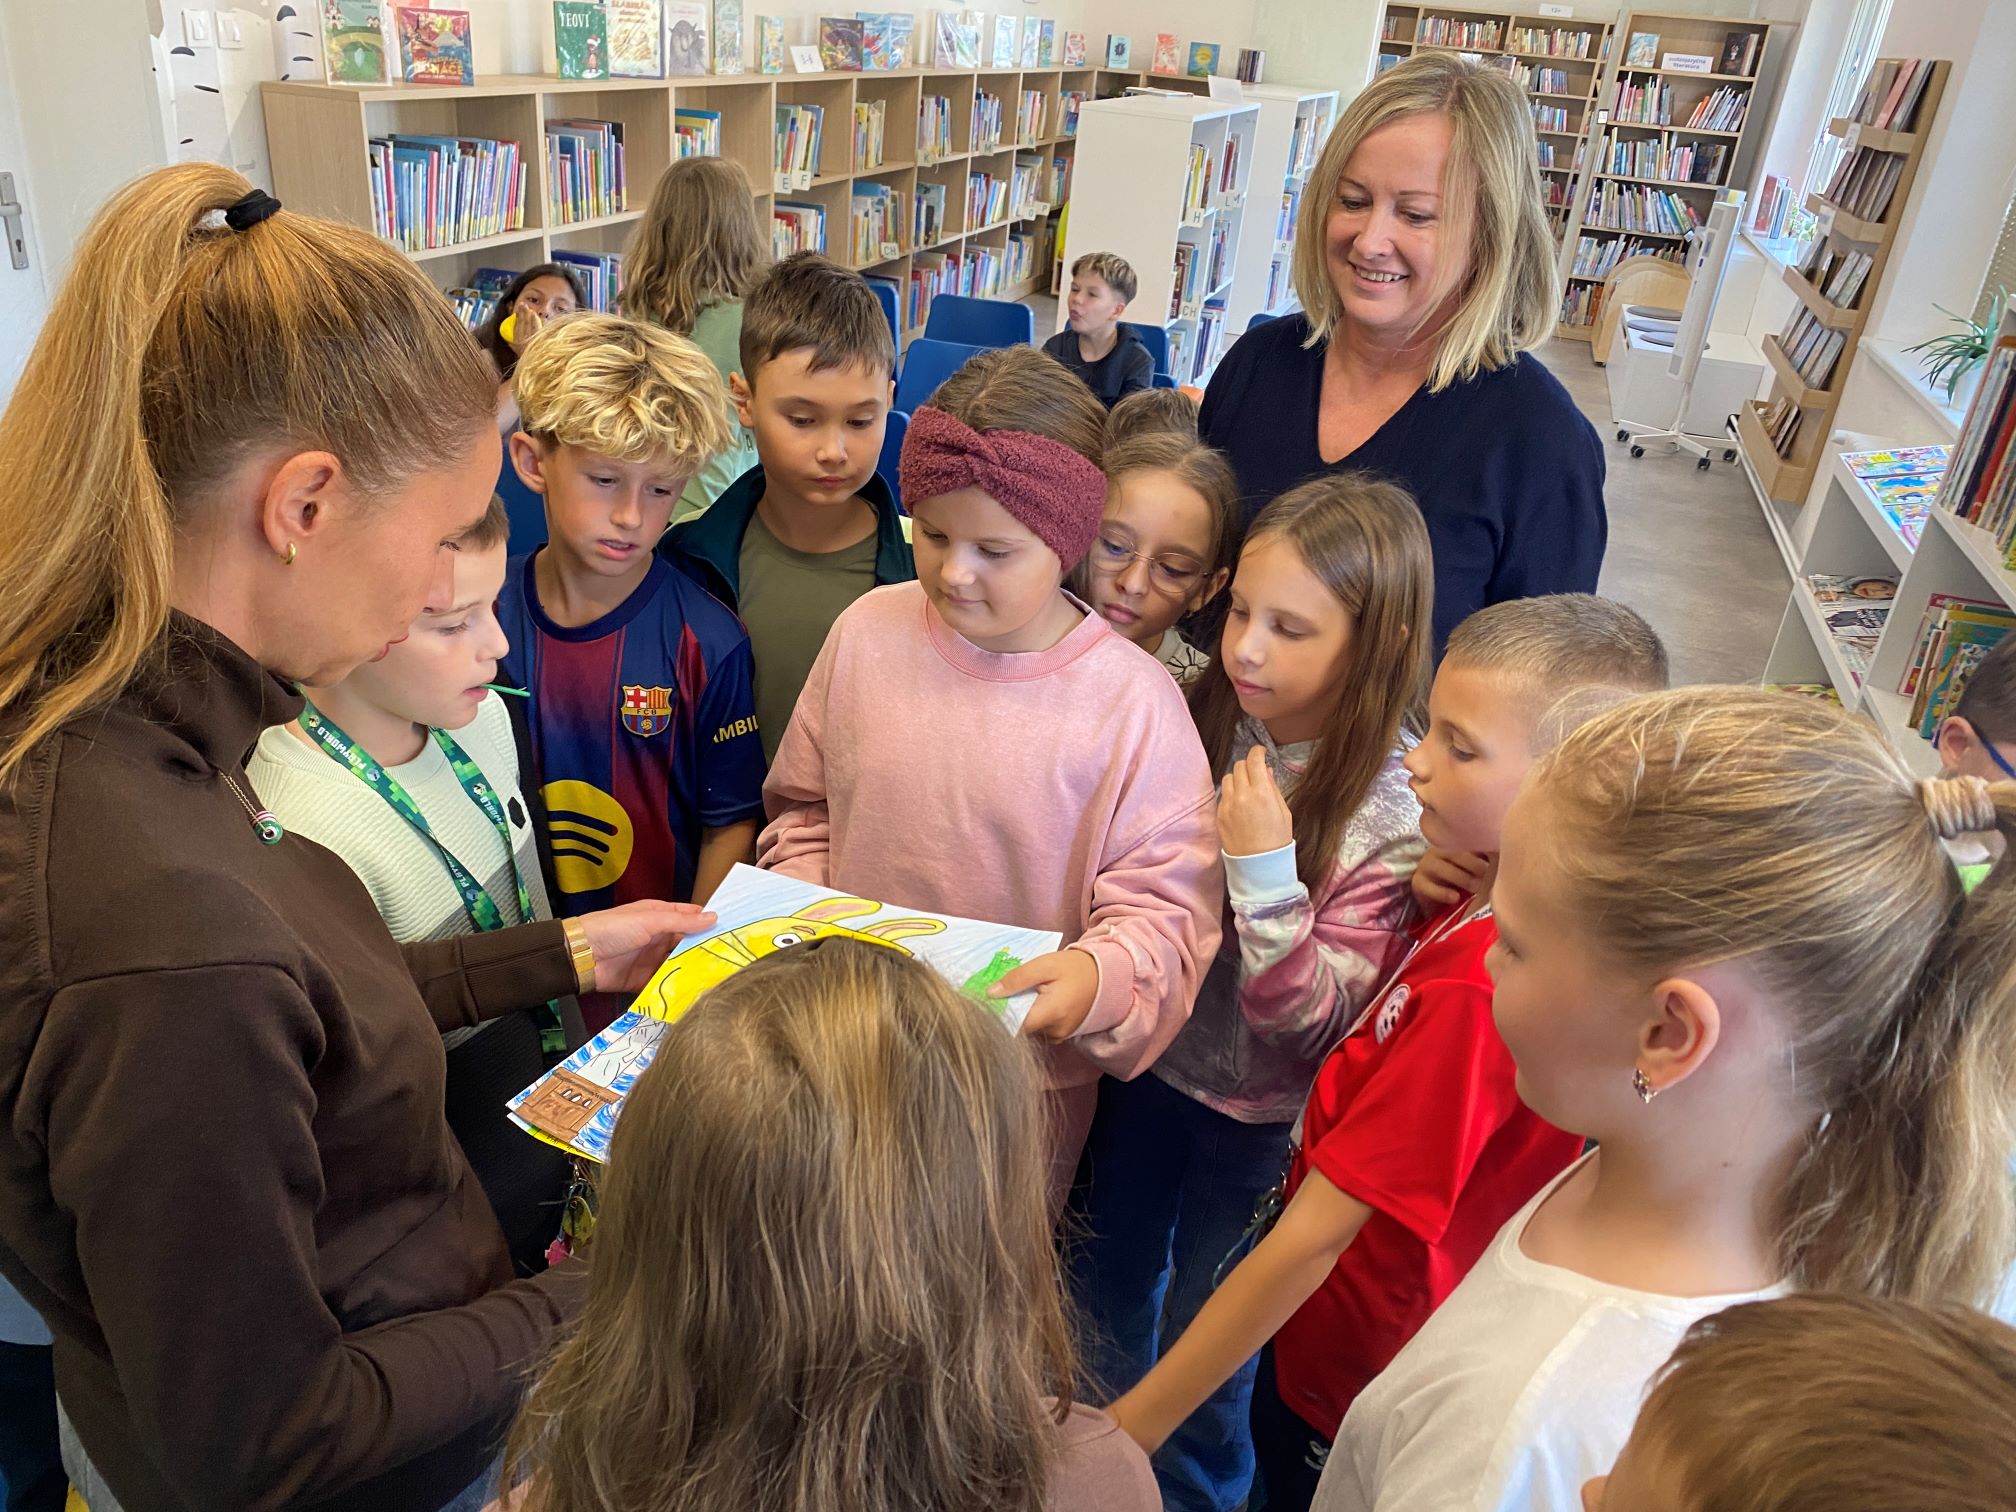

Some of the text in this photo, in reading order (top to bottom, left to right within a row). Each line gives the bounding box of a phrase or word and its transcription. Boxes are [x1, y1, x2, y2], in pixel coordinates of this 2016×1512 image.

[782, 177, 789, 190] E
[800, 174, 808, 186] F
[1193, 213, 1201, 224] H
[883, 246, 897, 257] CH
[1182, 304, 1198, 318] CH
